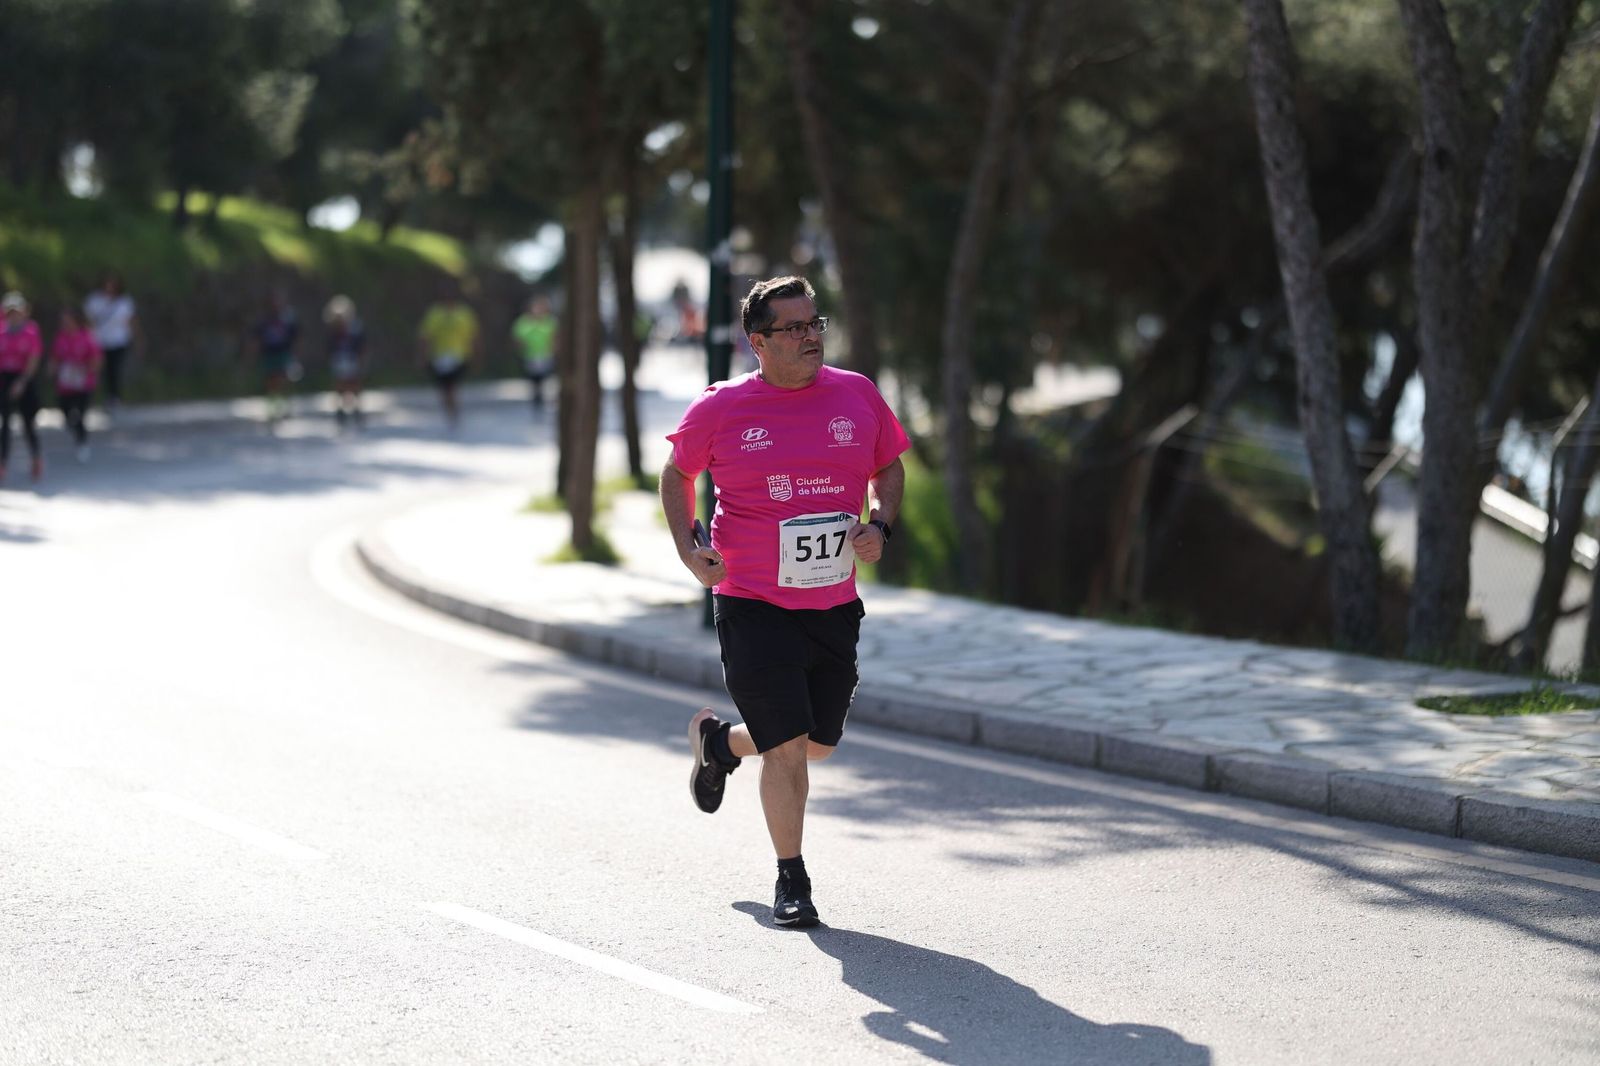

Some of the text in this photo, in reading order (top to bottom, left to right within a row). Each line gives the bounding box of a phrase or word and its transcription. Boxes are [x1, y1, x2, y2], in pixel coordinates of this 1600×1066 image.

[740, 440, 774, 451] HYUNDAI
[796, 476, 831, 486] Ciudad
[798, 485, 845, 495] de Málaga
[795, 530, 847, 562] 517
